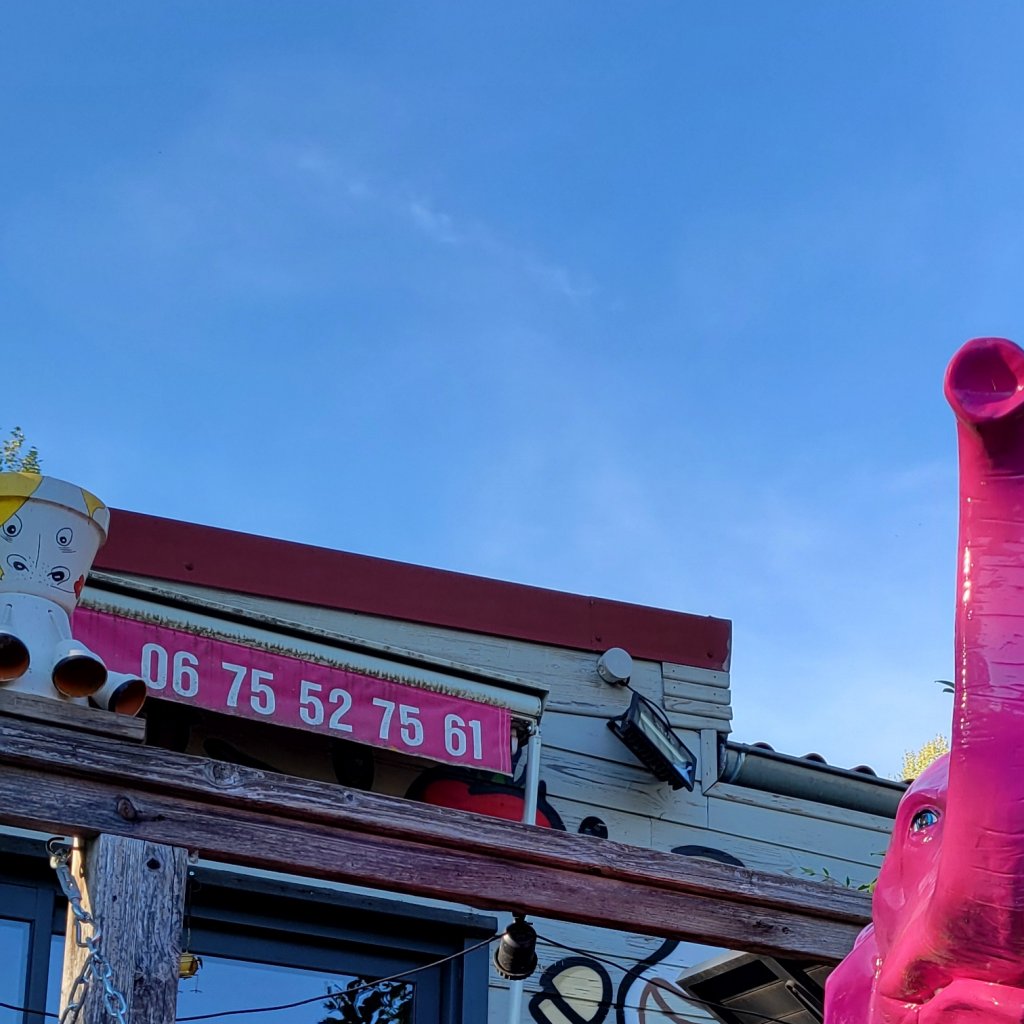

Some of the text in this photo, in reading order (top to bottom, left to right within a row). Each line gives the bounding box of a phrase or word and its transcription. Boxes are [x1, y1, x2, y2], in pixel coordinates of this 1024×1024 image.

[141, 643, 483, 760] 06 75 52 75 61
